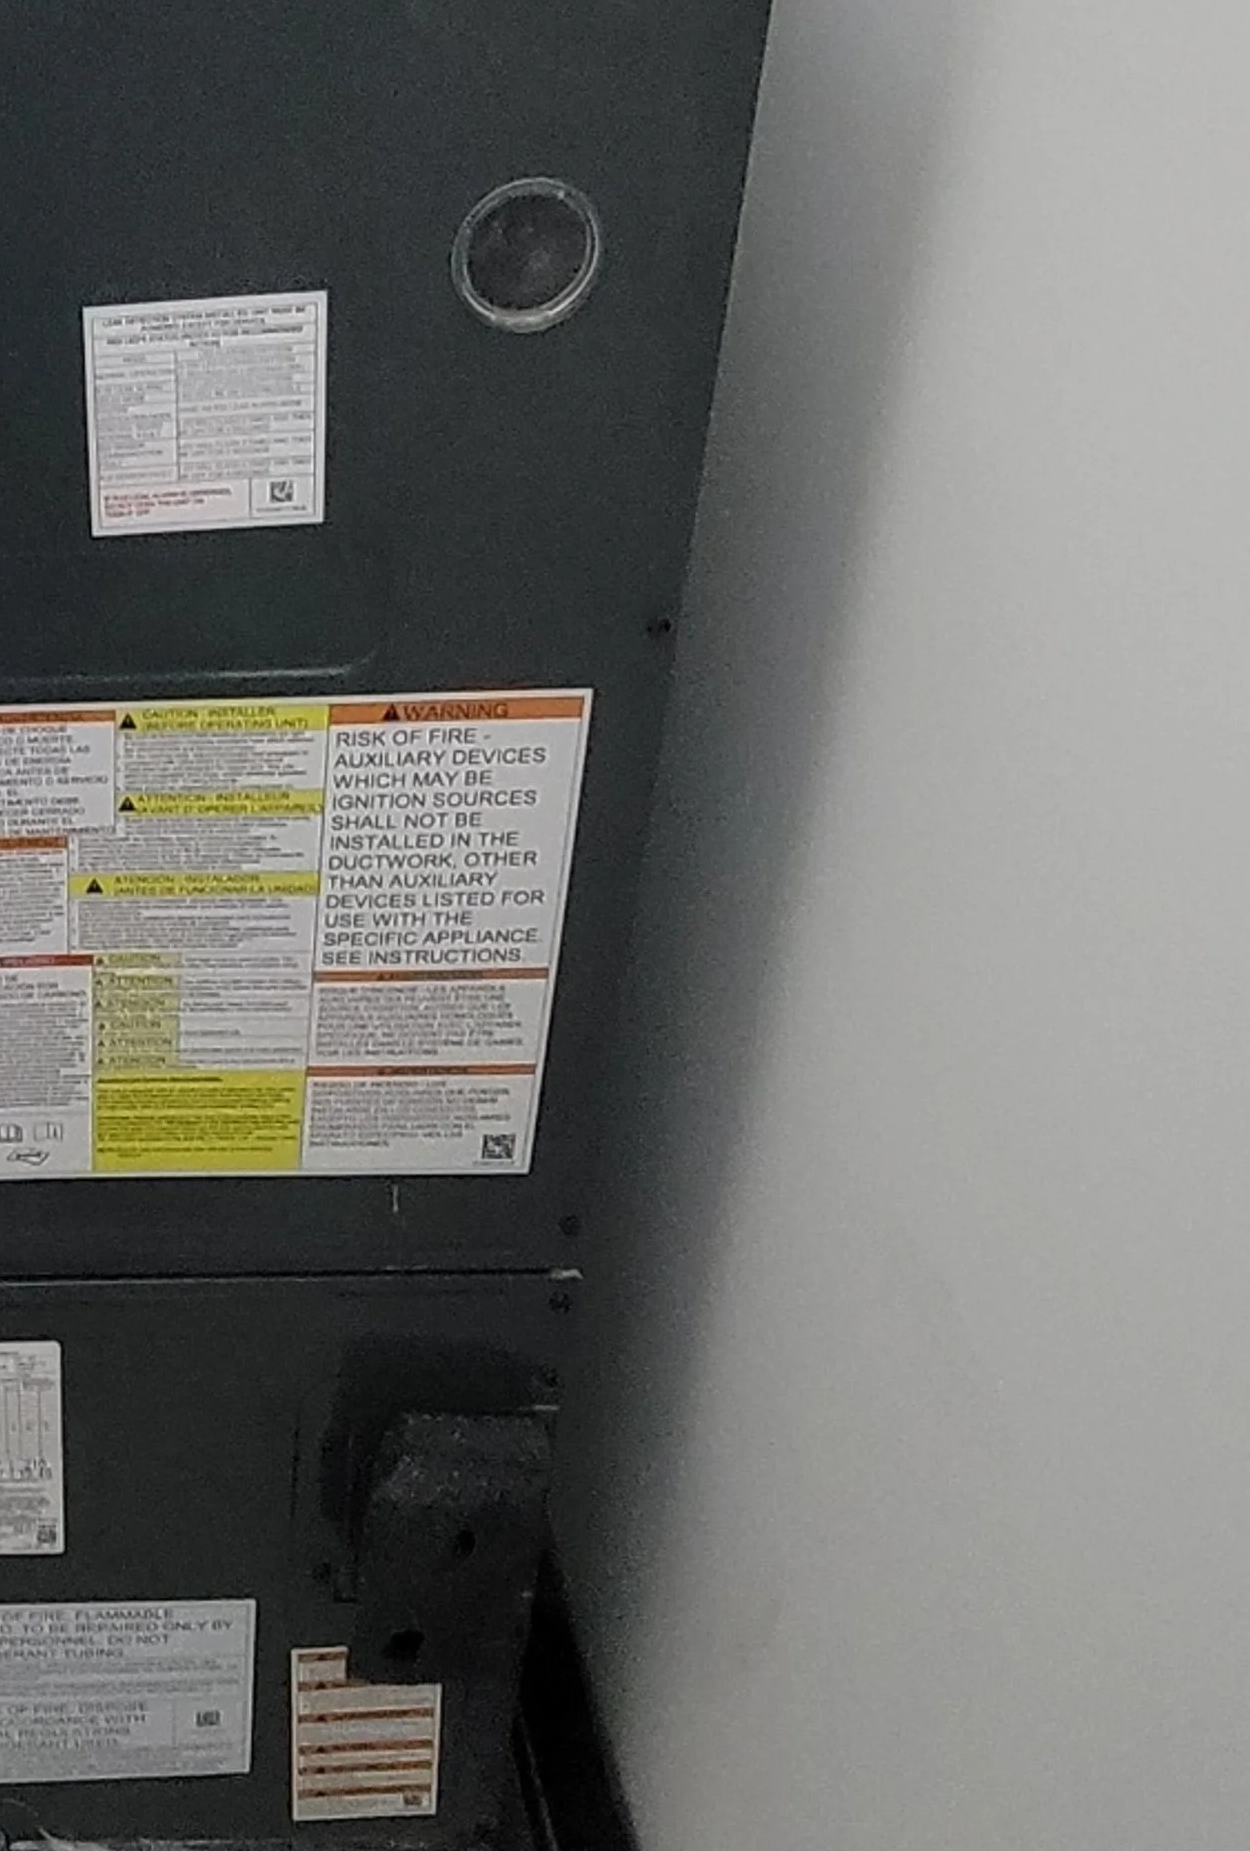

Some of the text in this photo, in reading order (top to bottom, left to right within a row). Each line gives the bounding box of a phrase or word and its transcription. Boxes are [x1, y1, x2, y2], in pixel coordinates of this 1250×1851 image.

[403, 704, 509, 720] WARNING
[336, 731, 386, 747] RISK
[393, 730, 422, 746] OF
[429, 728, 478, 744] FIRE
[335, 748, 546, 768] AUXILIARY DEVICES
[333, 770, 492, 789] WHICH MAY BE
[333, 790, 538, 810] IGNITION SOURCES
[331, 812, 482, 830] SHALL NOT BE
[330, 832, 519, 849] INSTALLED IN THE
[328, 851, 538, 870] DUCTWORK, OTHER
[328, 872, 498, 890] THAN AUXILIARY
[326, 890, 545, 909] DEVICES LISTED FOR
[324, 911, 472, 928] USE WITH THE
[323, 931, 417, 947] SPECIFIC
[322, 951, 362, 965] SEE
[163, 1621, 207, 1630] ONLY
